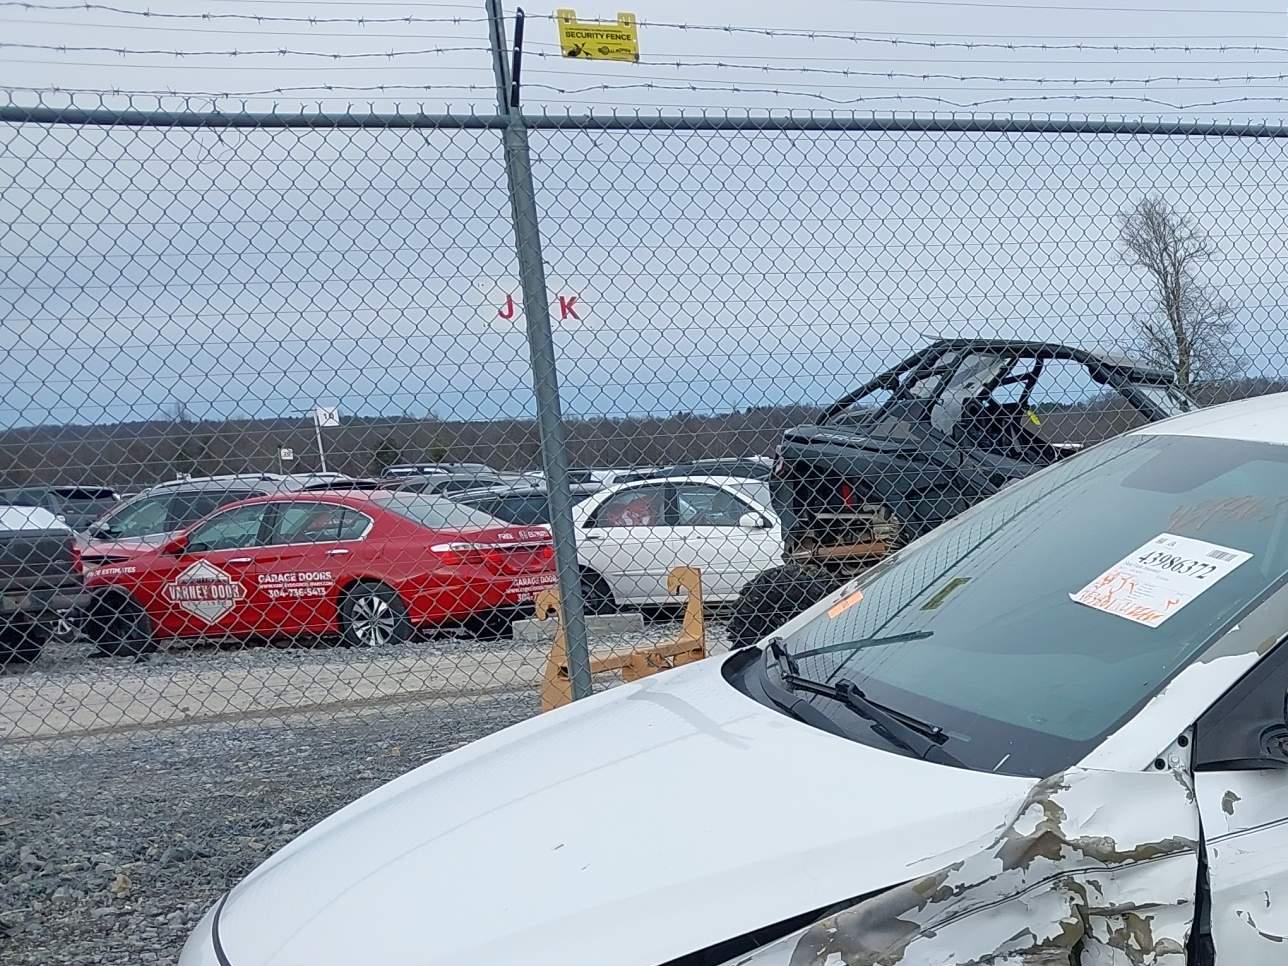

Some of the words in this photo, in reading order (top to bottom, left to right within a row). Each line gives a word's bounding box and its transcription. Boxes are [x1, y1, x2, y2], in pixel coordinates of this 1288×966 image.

[565, 31, 605, 39] SECURITY
[606, 33, 631, 41] FENCE
[1137, 550, 1218, 580] 43986372
[258, 573, 297, 584] GARAGE
[298, 570, 332, 582] DOORS
[168, 584, 208, 601] VARNEY
